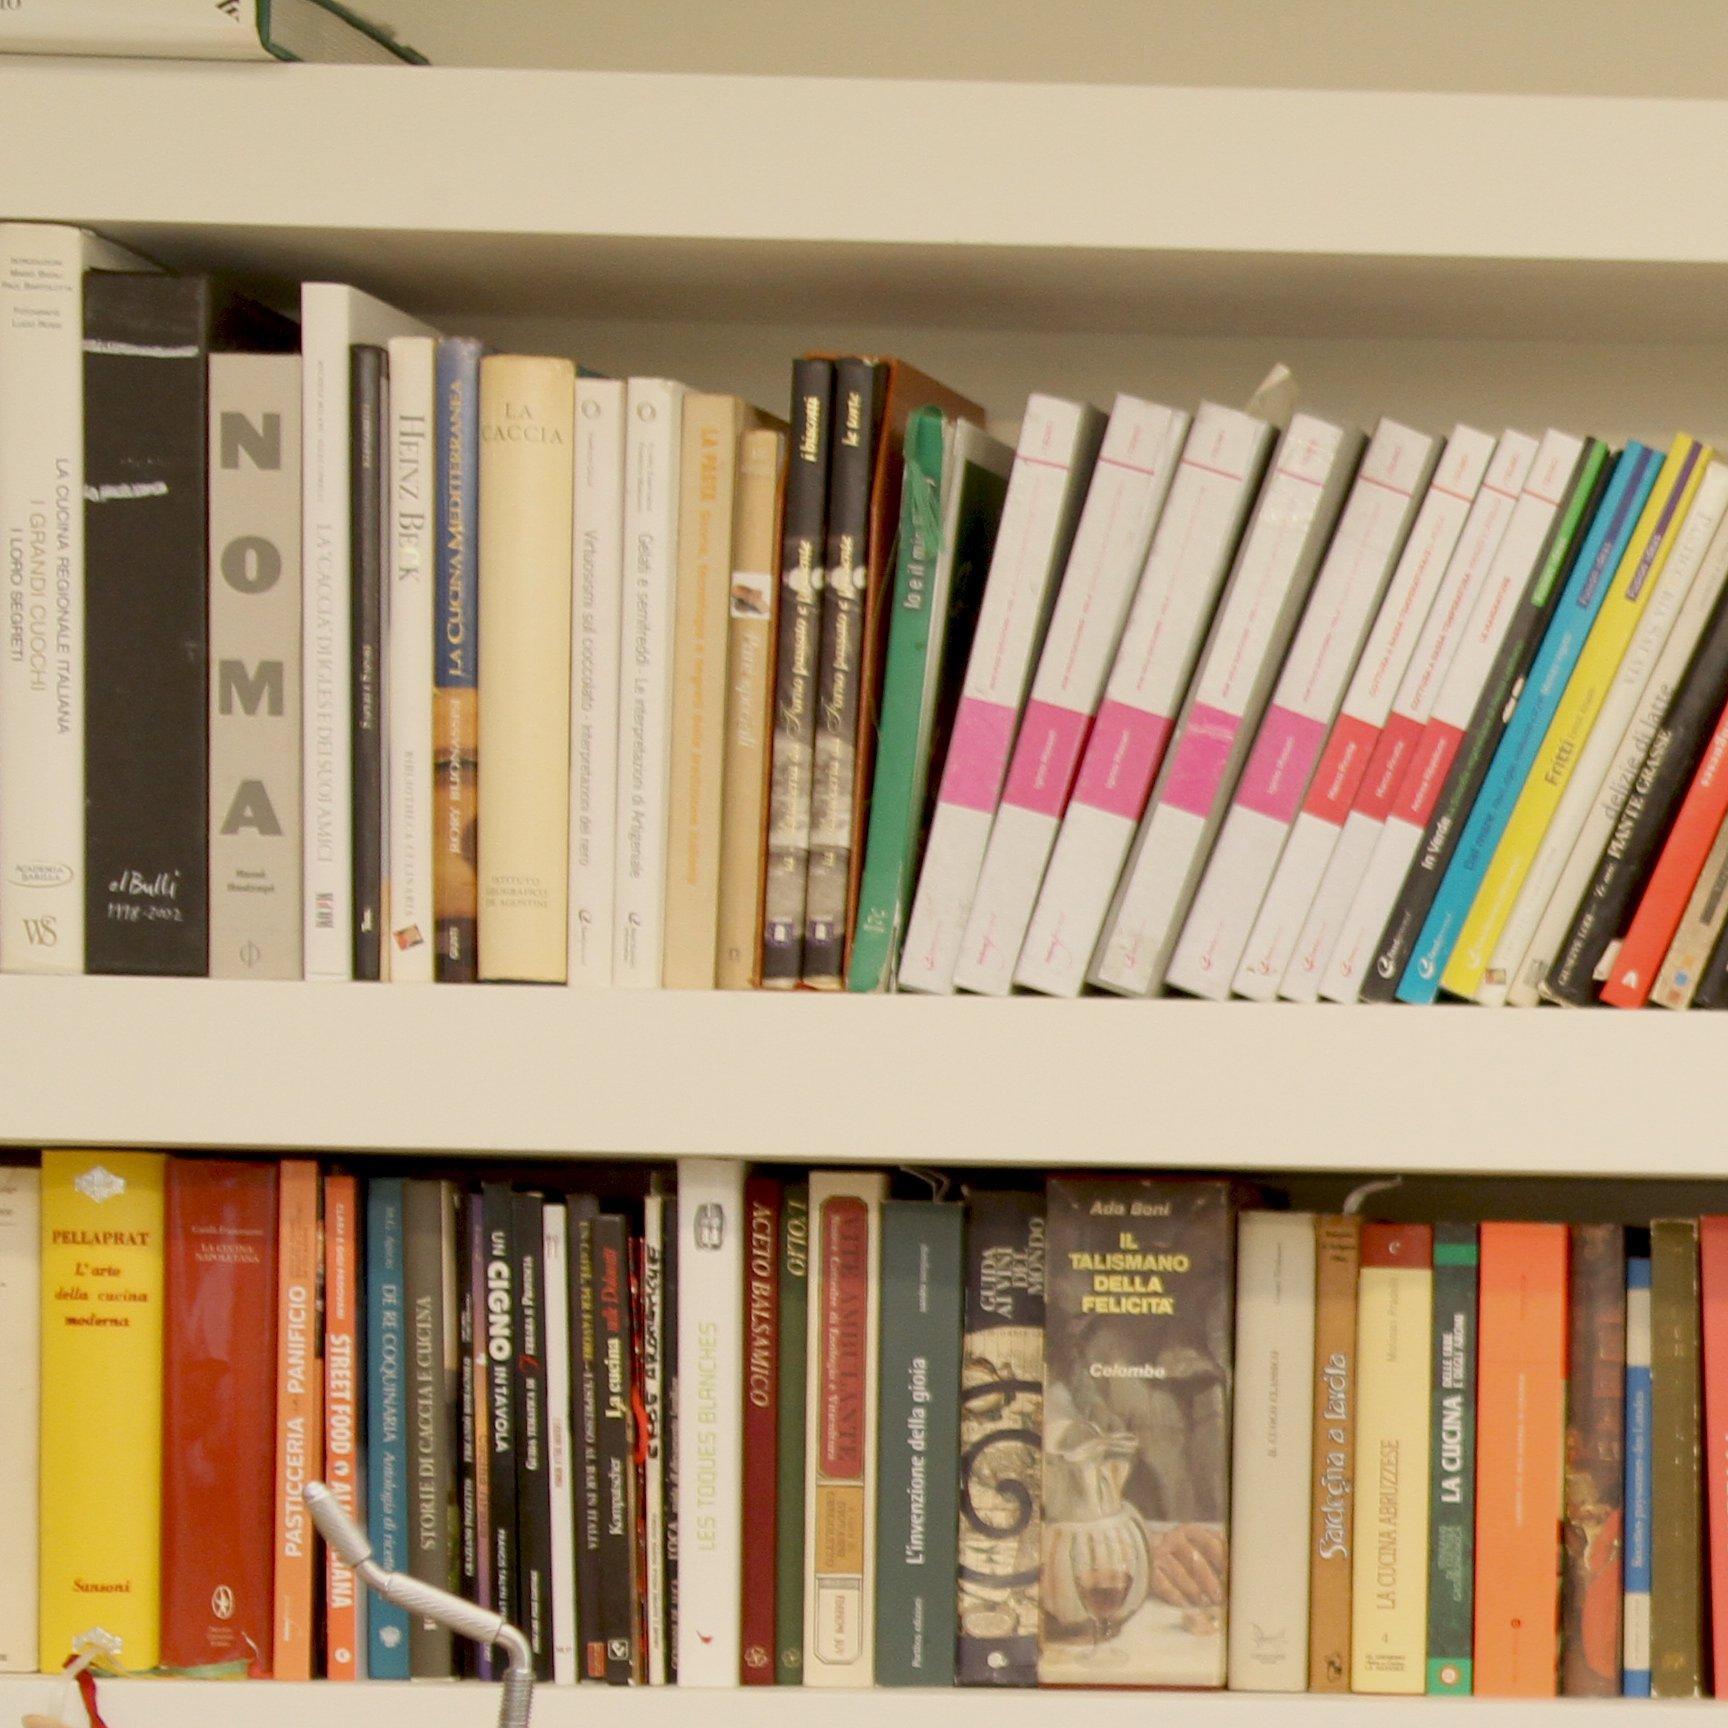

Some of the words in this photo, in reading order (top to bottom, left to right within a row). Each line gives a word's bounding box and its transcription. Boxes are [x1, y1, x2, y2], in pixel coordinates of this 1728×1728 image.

[481, 424, 564, 445] CACCIA
[504, 403, 532, 420] LA
[56, 457, 70, 471] LA
[399, 413, 425, 501] HEINZ
[446, 379, 465, 550] MEDITERRANEA
[56, 474, 71, 551] CUCINA
[10, 536, 23, 586] LORO
[29, 513, 46, 600] GRANDI
[580, 529, 597, 609] Virtuosismi
[634, 533, 653, 577] Gelati
[11, 590, 24, 663] SEGRETI
[57, 556, 71, 655] REGIONALE
[218, 409, 285, 838] NOMA
[446, 551, 464, 645] CUCINA
[633, 590, 651, 669] semifreddi
[29, 604, 47, 693] CUOCHI
[446, 648, 462, 676] LA
[579, 636, 596, 711] cioccolato
[57, 659, 72, 736] ITALIANA
[633, 677, 650, 694] Le
[1545, 740, 1577, 785] Fritti
[1602, 758, 1645, 821] delizie
[1606, 794, 1644, 860] PIANTE
[1633, 727, 1672, 794] GRASSE
[448, 804, 462, 854] RORY
[1425, 815, 1451, 853] Verde
[51, 1229, 149, 1246] PELLAPRAT
[748, 1203, 771, 1277] ACETO
[784, 1201, 807, 1277] L'OLIO
[1089, 1200, 1125, 1217] Ada
[1129, 1200, 1171, 1217] Boni
[1119, 1231, 1139, 1250] IL
[489, 1231, 506, 1257] UN
[1026, 1216, 1046, 1296] MONDO
[1068, 1252, 1191, 1273] TALISMANO
[380, 1283, 399, 1303] DE
[487, 1260, 512, 1361] CIGNO
[980, 1246, 997, 1312] GUIDA
[1093, 1274, 1164, 1294] DELLA
[64, 1316, 130, 1327] moderna
[285, 1284, 305, 1394] PANIFICIO
[380, 1305, 399, 1331] RE
[415, 1295, 435, 1367] CUCINA
[747, 1280, 770, 1407] BALSAMICO
[329, 1333, 351, 1402] STREET
[380, 1332, 400, 1443] COQUINARIA
[492, 1365, 508, 1382] IN
[604, 1339, 622, 1393] cucina
[697, 1321, 718, 1424] BLANCHES
[908, 1357, 929, 1404] gioia
[1089, 1363, 1166, 1379] Colombo
[329, 1404, 351, 1454] FOOD
[417, 1386, 436, 1454] CACCIA
[492, 1383, 509, 1452] TAVOLA
[605, 1396, 625, 1419] La
[907, 1405, 925, 1452] della
[1441, 1395, 1464, 1472] CUCINA
[284, 1416, 307, 1557] PASTICCERIA
[380, 1450, 400, 1514] Antologia
[418, 1454, 436, 1478] DI
[697, 1430, 718, 1510] TOQUES
[1377, 1438, 1401, 1527] ABRUZZESE
[1441, 1473, 1462, 1503] LA
[380, 1516, 399, 1532] di
[418, 1478, 437, 1551] STORIE
[697, 1514, 718, 1553] LES
[905, 1457, 925, 1564] L'invenzione
[1318, 1452, 1352, 1560] Sardegna
[73, 1580, 131, 1593] Sansoni
[1377, 1529, 1399, 1588] CUCINA
[1376, 1589, 1397, 1610] LA
